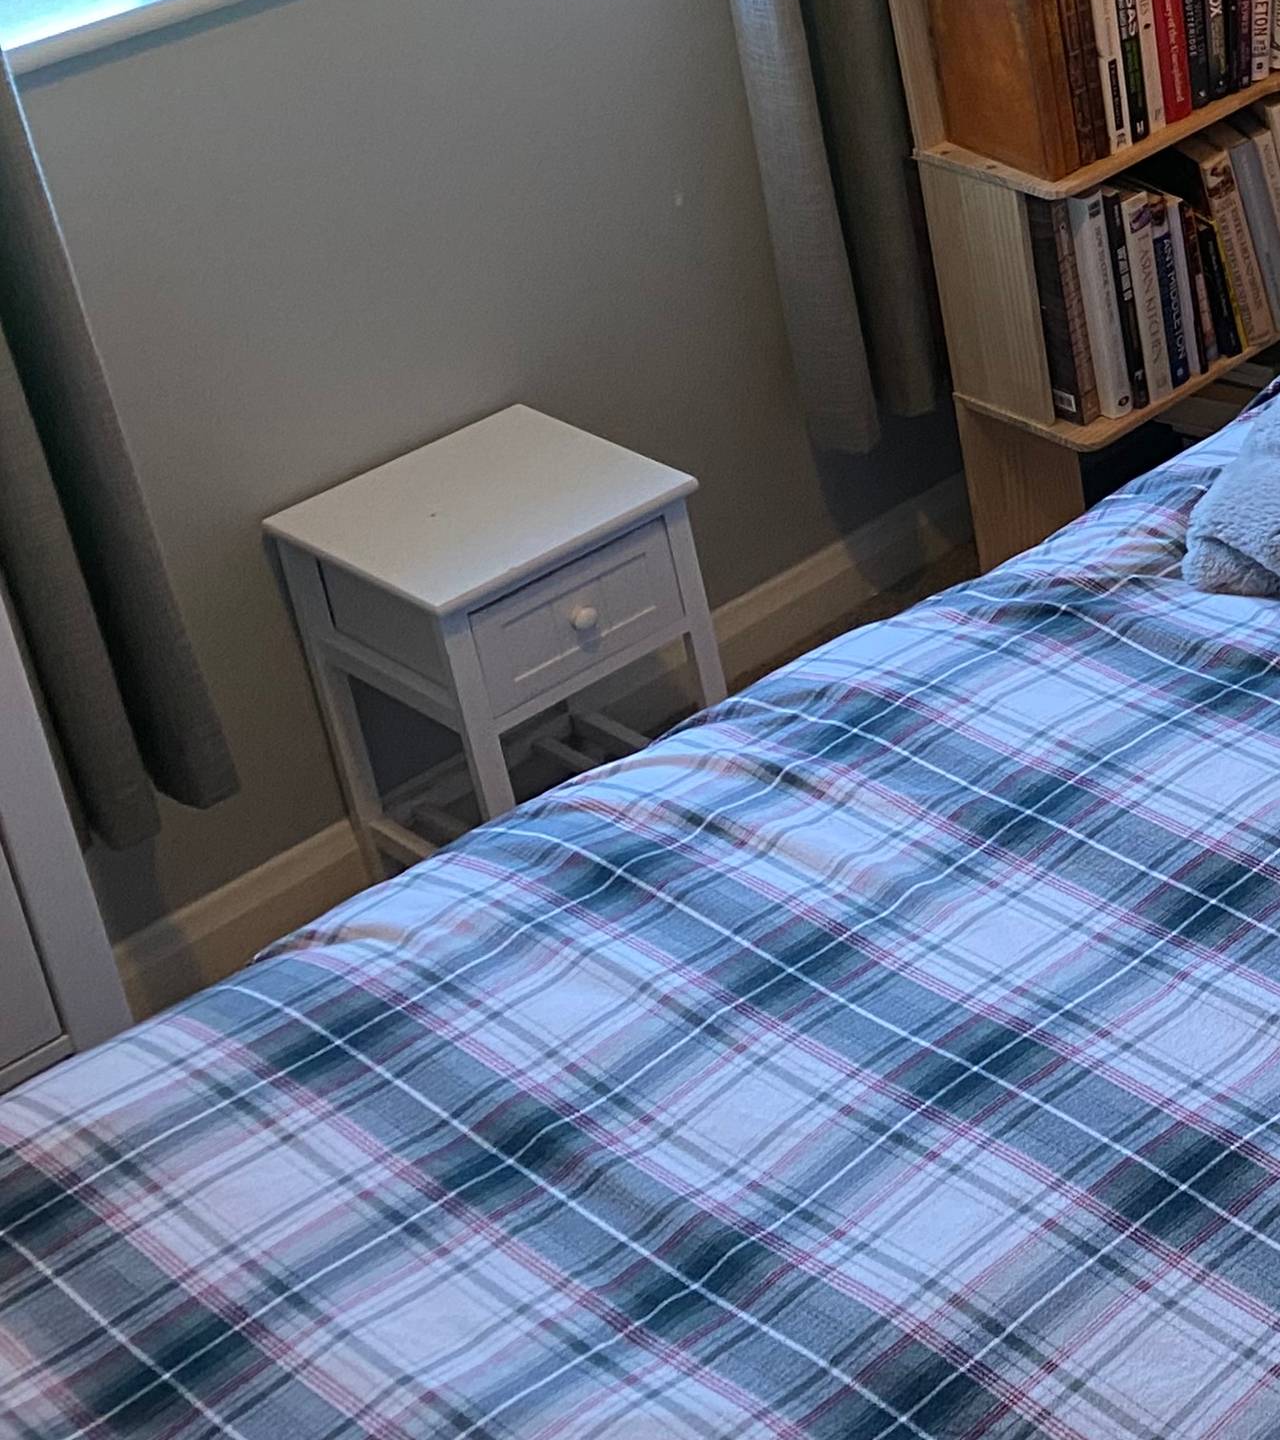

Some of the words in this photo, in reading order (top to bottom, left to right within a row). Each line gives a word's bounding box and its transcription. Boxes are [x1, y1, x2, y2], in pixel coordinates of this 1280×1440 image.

[1140, 248, 1154, 293] ASIAN
[1163, 238, 1175, 270] ANT
[1145, 295, 1161, 365] KITCHEN
[1167, 271, 1187, 361] MIDDLETON
